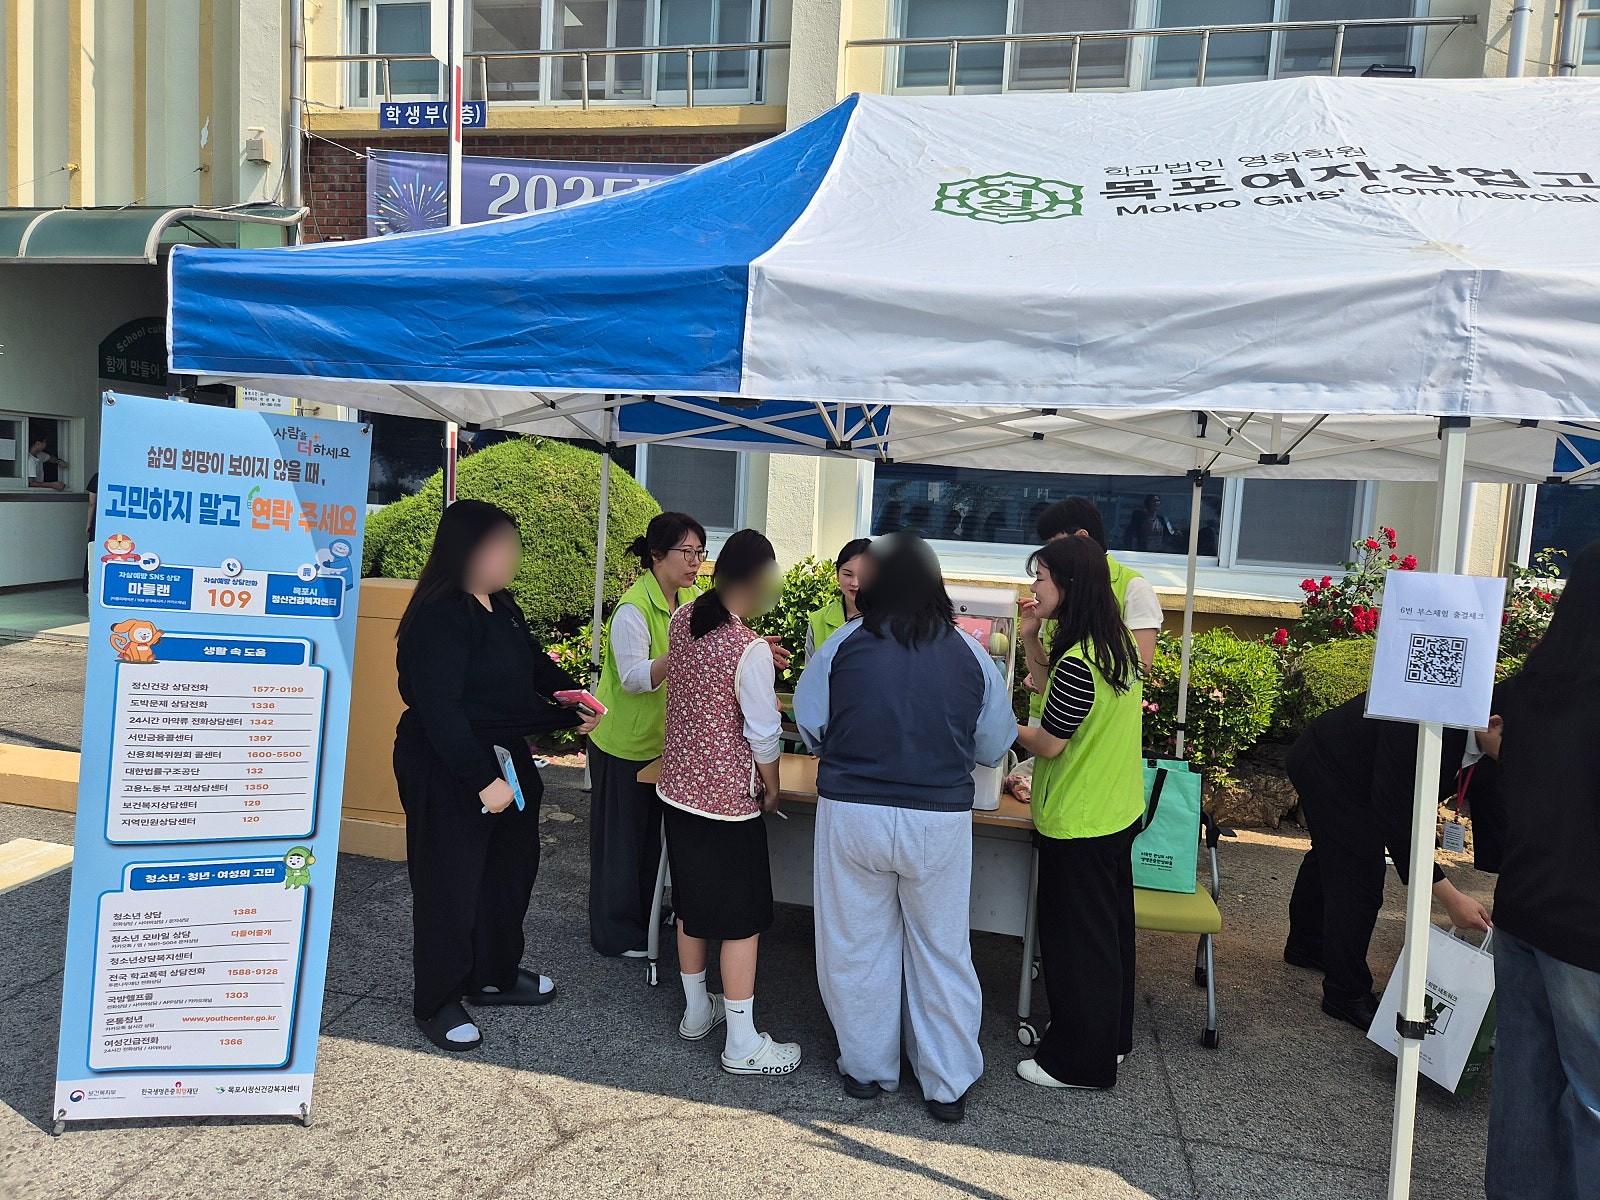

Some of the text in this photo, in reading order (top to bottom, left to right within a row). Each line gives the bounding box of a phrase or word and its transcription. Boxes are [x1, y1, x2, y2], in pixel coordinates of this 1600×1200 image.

[386, 104, 480, 124] 학생부(층)
[1104, 145, 1368, 176] 학교법인 영화학원
[1116, 185, 1599, 216] Mokpo Girls' Commercial
[117, 327, 146, 352] School
[106, 356, 127, 374] 함께
[131, 360, 159, 379] 만들어
[274, 426, 307, 440] 사람을
[298, 440, 350, 458] 더하세요
[148, 446, 325, 486] 삶의 희망이 보이지 않을 때,
[105, 484, 357, 536] 고민하지 말고 연락 주세요
[128, 582, 170, 596] 마들랜
[293, 587, 318, 596] 목포시
[208, 589, 251, 608] 109
[272, 595, 336, 606] 정신건강복지센터
[1400, 607, 1412, 615] 6번
[1417, 608, 1449, 618] 부스체험
[204, 646, 266, 657] 생활 속 도움
[132, 682, 170, 691] 정신건강
[172, 684, 209, 692] 상담전화
[130, 699, 168, 708] 도박문제
[171, 700, 208, 708] 상담전화
[129, 716, 160, 725] 24시간
[162, 717, 188, 725] 마약류
[192, 717, 243, 726] 전화상담센터
[128, 733, 193, 742] 서민금융콜센터
[127, 751, 192, 759] 신용회복위원회
[125, 768, 200, 776] 대한법률구조공단
[173, 784, 228, 792] 고객상담센터
[122, 801, 197, 809] 보건복지상담센터
[121, 818, 196, 826] 지역민원상담센터
[145, 873, 180, 883] 청소년
[188, 872, 210, 881] 청년
[217, 869, 250, 879] 여성의
[253, 868, 275, 877] 고민
[113, 908, 257, 921] 청소년 상담 1388
[112, 934, 139, 943] 청소년
[142, 932, 169, 940] 모바일
[173, 930, 191, 939] 상담
[110, 952, 193, 965] 청소년상담복지센터
[108, 967, 278, 982] 전국 학교폭력 상담전화 1588-9128
[108, 993, 153, 1004] 국방헬프콜
[182, 1014, 276, 1023] www.youthcenter.go.kr
[104, 1036, 243, 1047] 여성긴급전화 1366
[762, 1062, 795, 1074] crocs
[142, 1088, 198, 1096] 한국생명존중희망재단
[228, 1086, 300, 1094] 목포시정신건강복지센터
